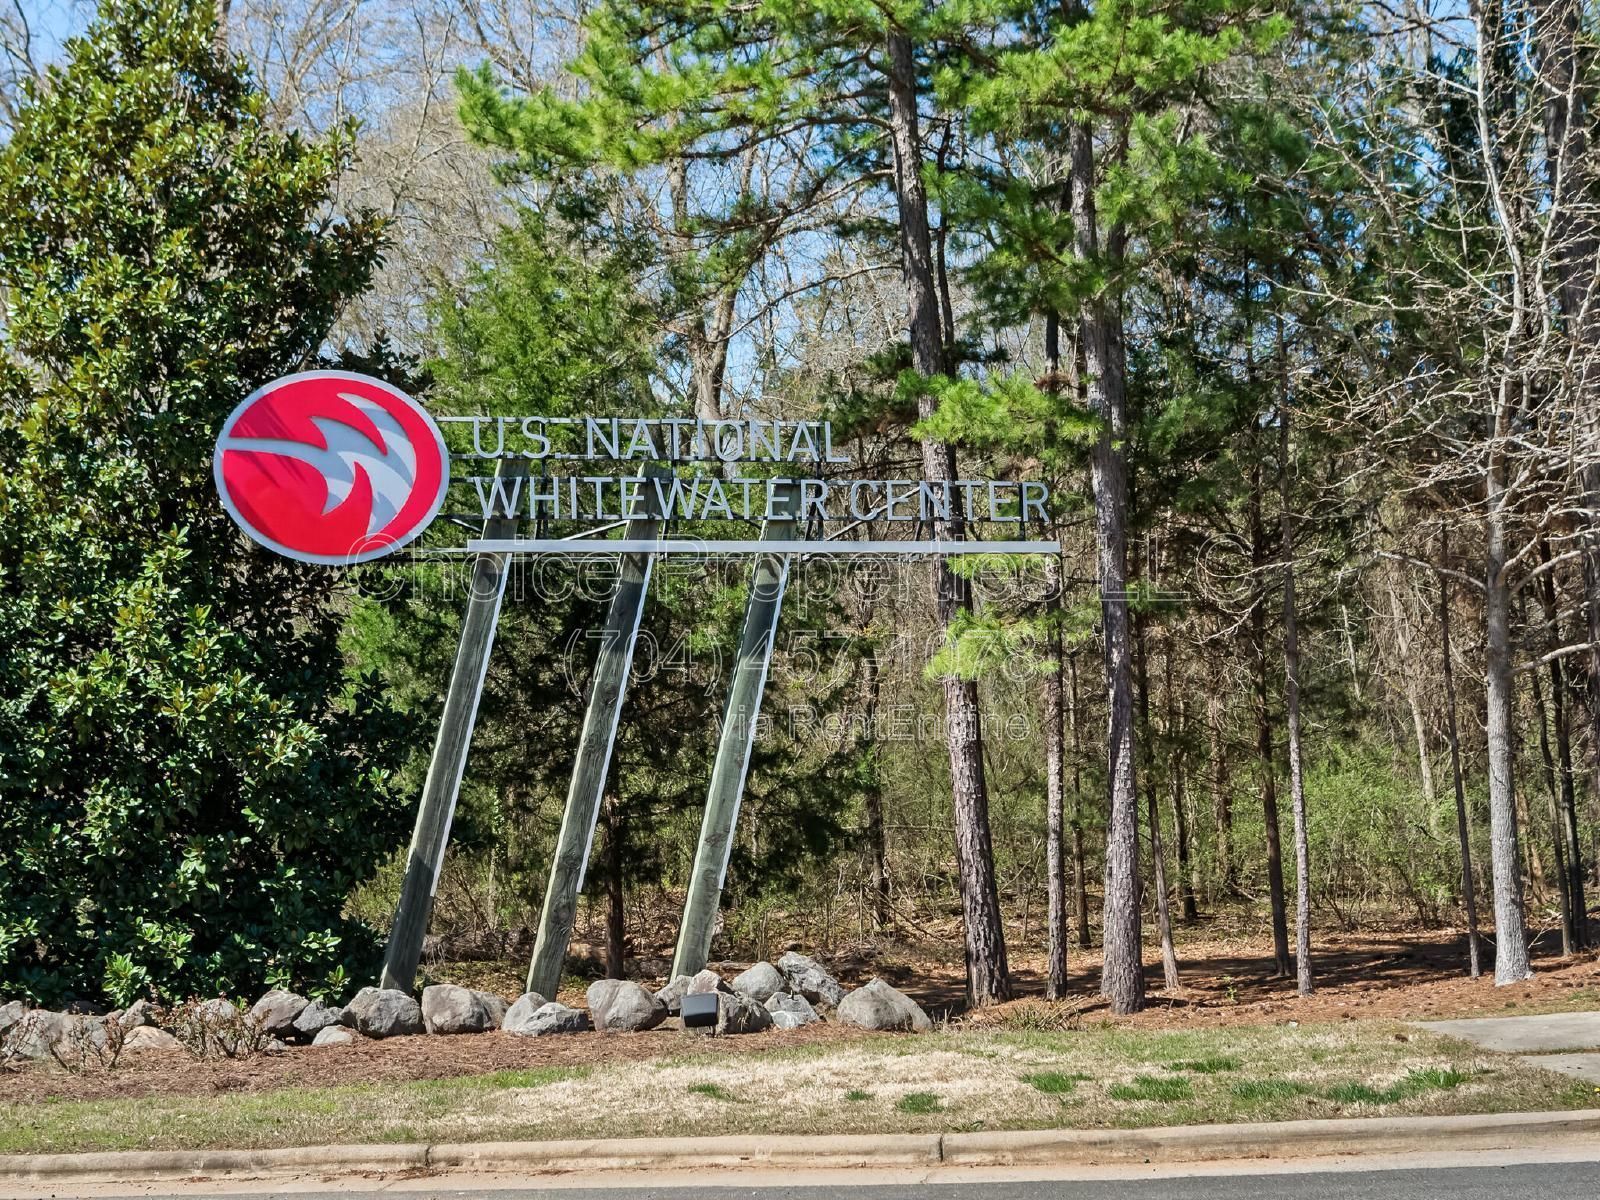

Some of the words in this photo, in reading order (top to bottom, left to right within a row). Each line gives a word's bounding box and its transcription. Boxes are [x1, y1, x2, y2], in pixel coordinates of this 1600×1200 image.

[586, 417, 850, 462] NATIONAL
[473, 476, 829, 521] WHITEWATER
[850, 480, 1050, 523] CENTER
